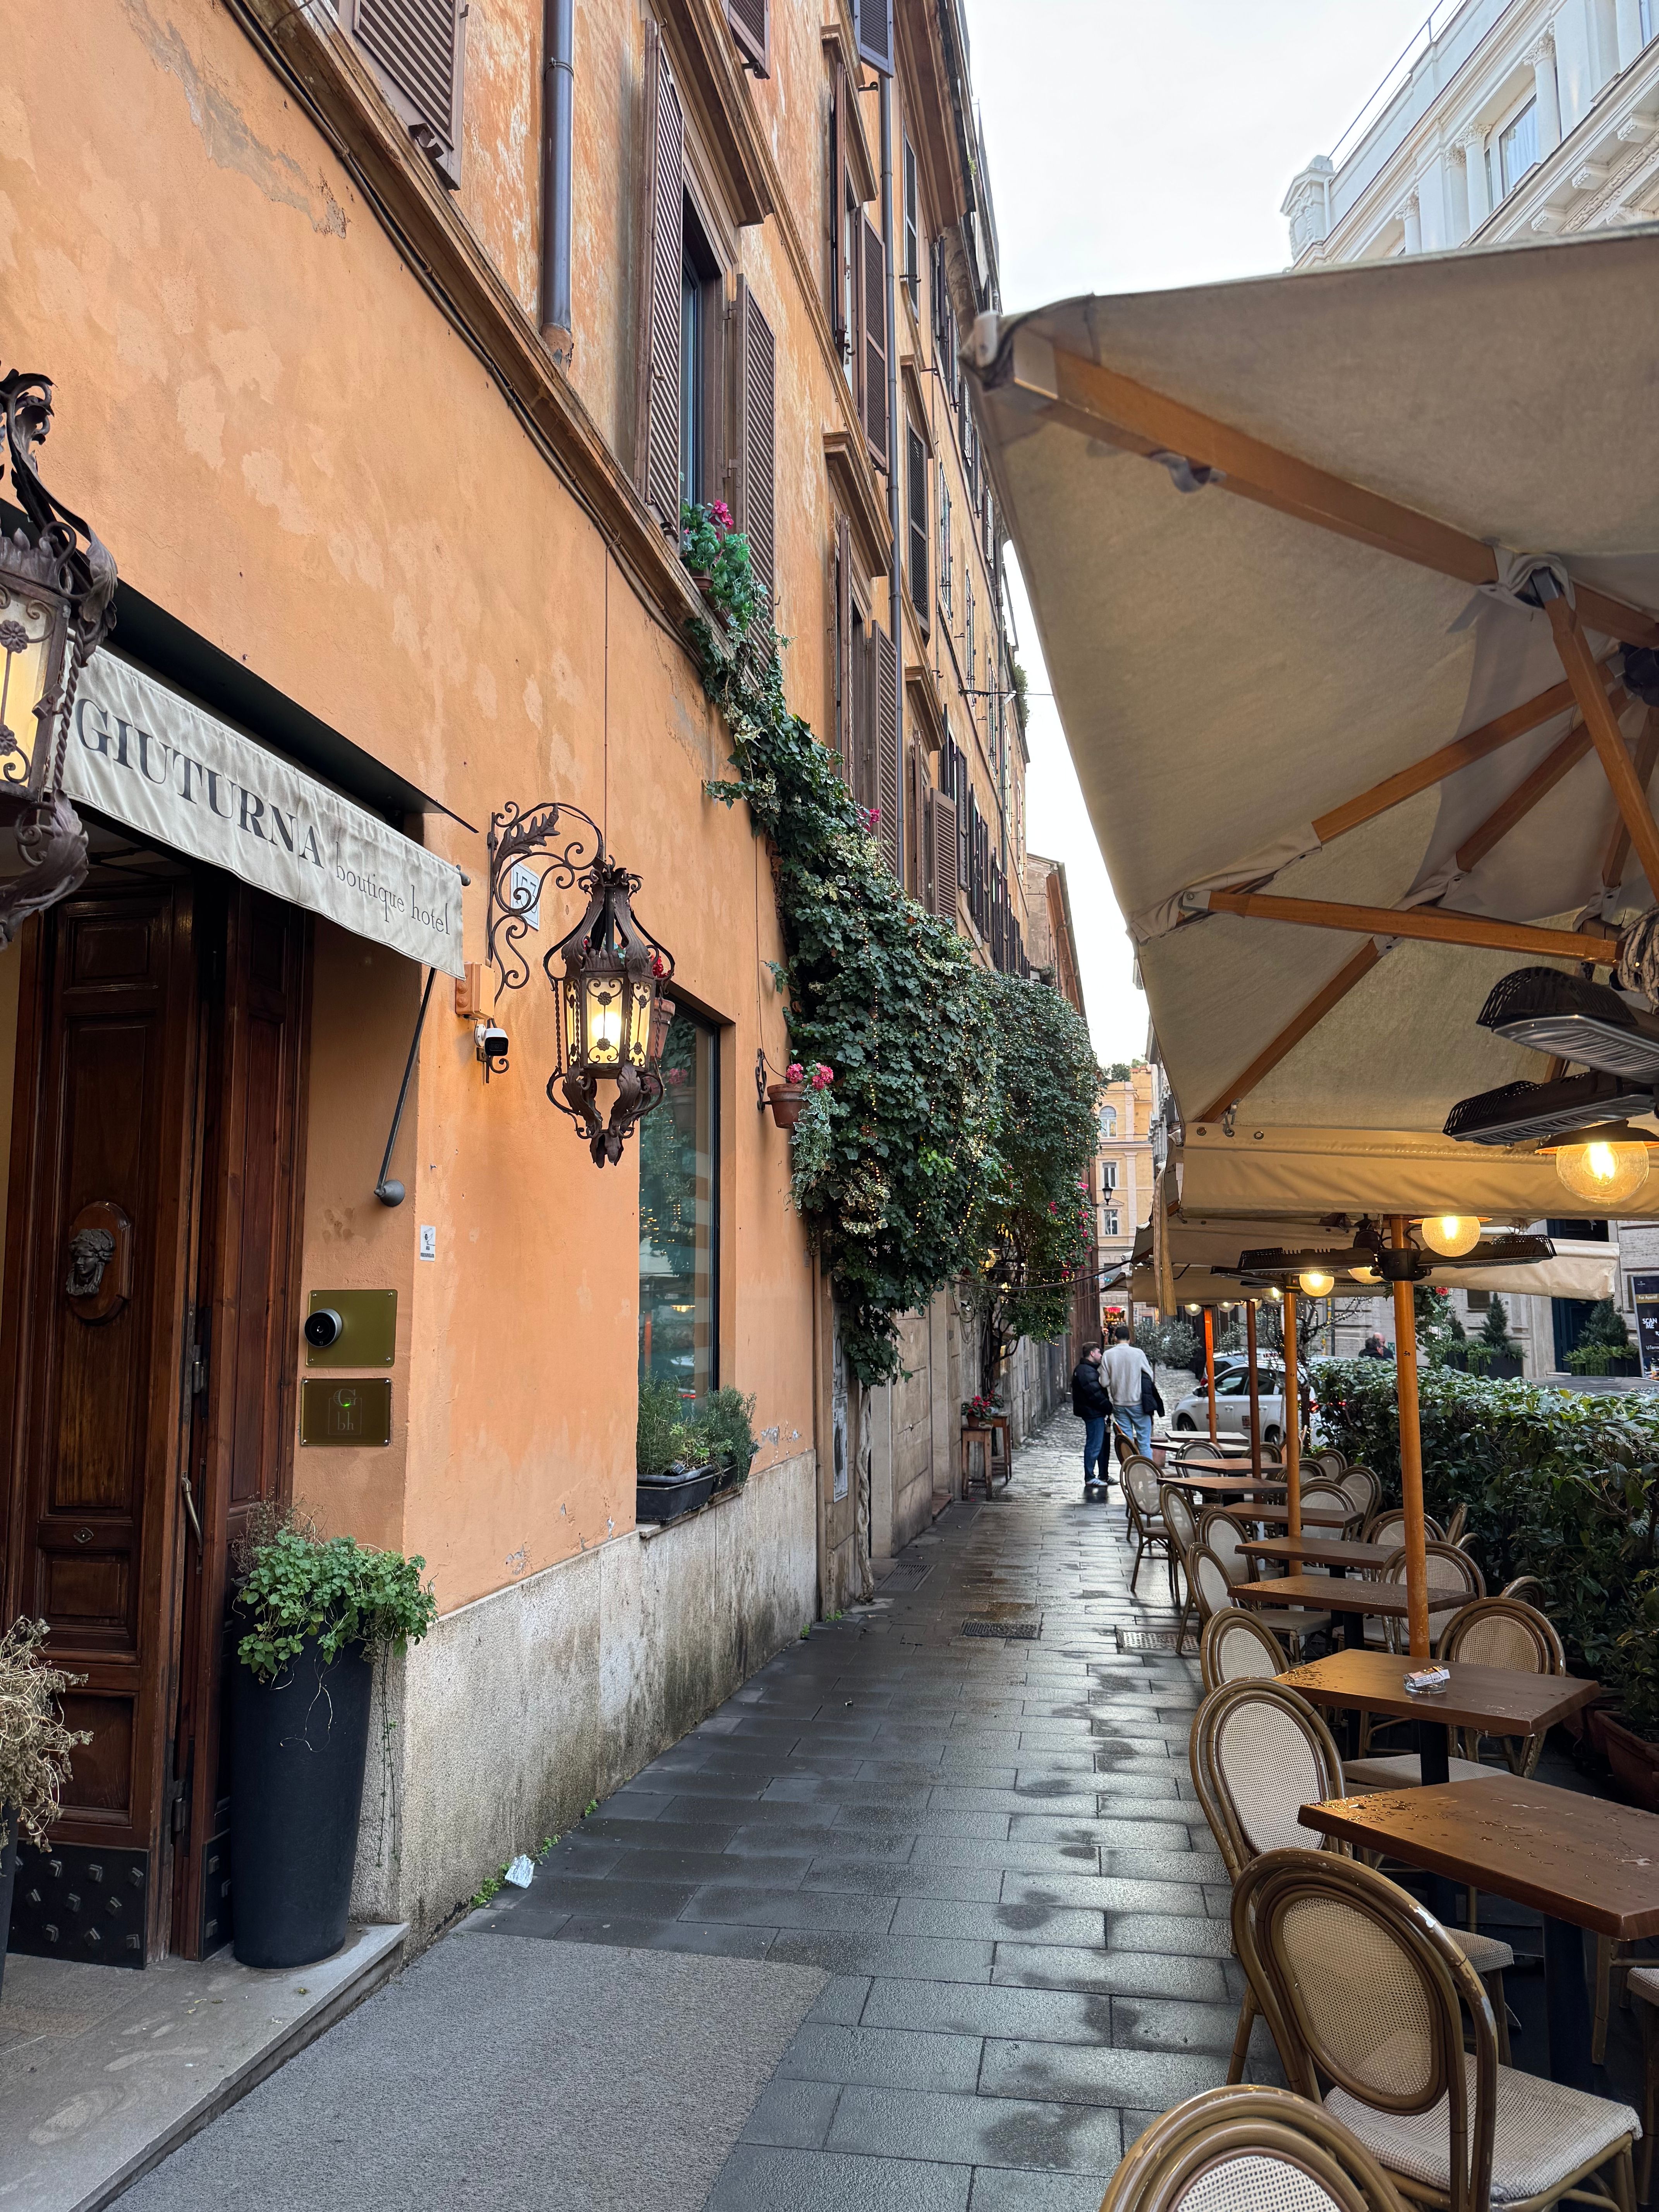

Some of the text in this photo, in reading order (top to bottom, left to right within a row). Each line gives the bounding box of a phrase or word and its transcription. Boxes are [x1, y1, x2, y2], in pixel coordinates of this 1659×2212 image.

[77, 698, 450, 936] GIUTURNA boutique hotel
[333, 1389, 357, 1407] G
[338, 1411, 354, 1430] bh
